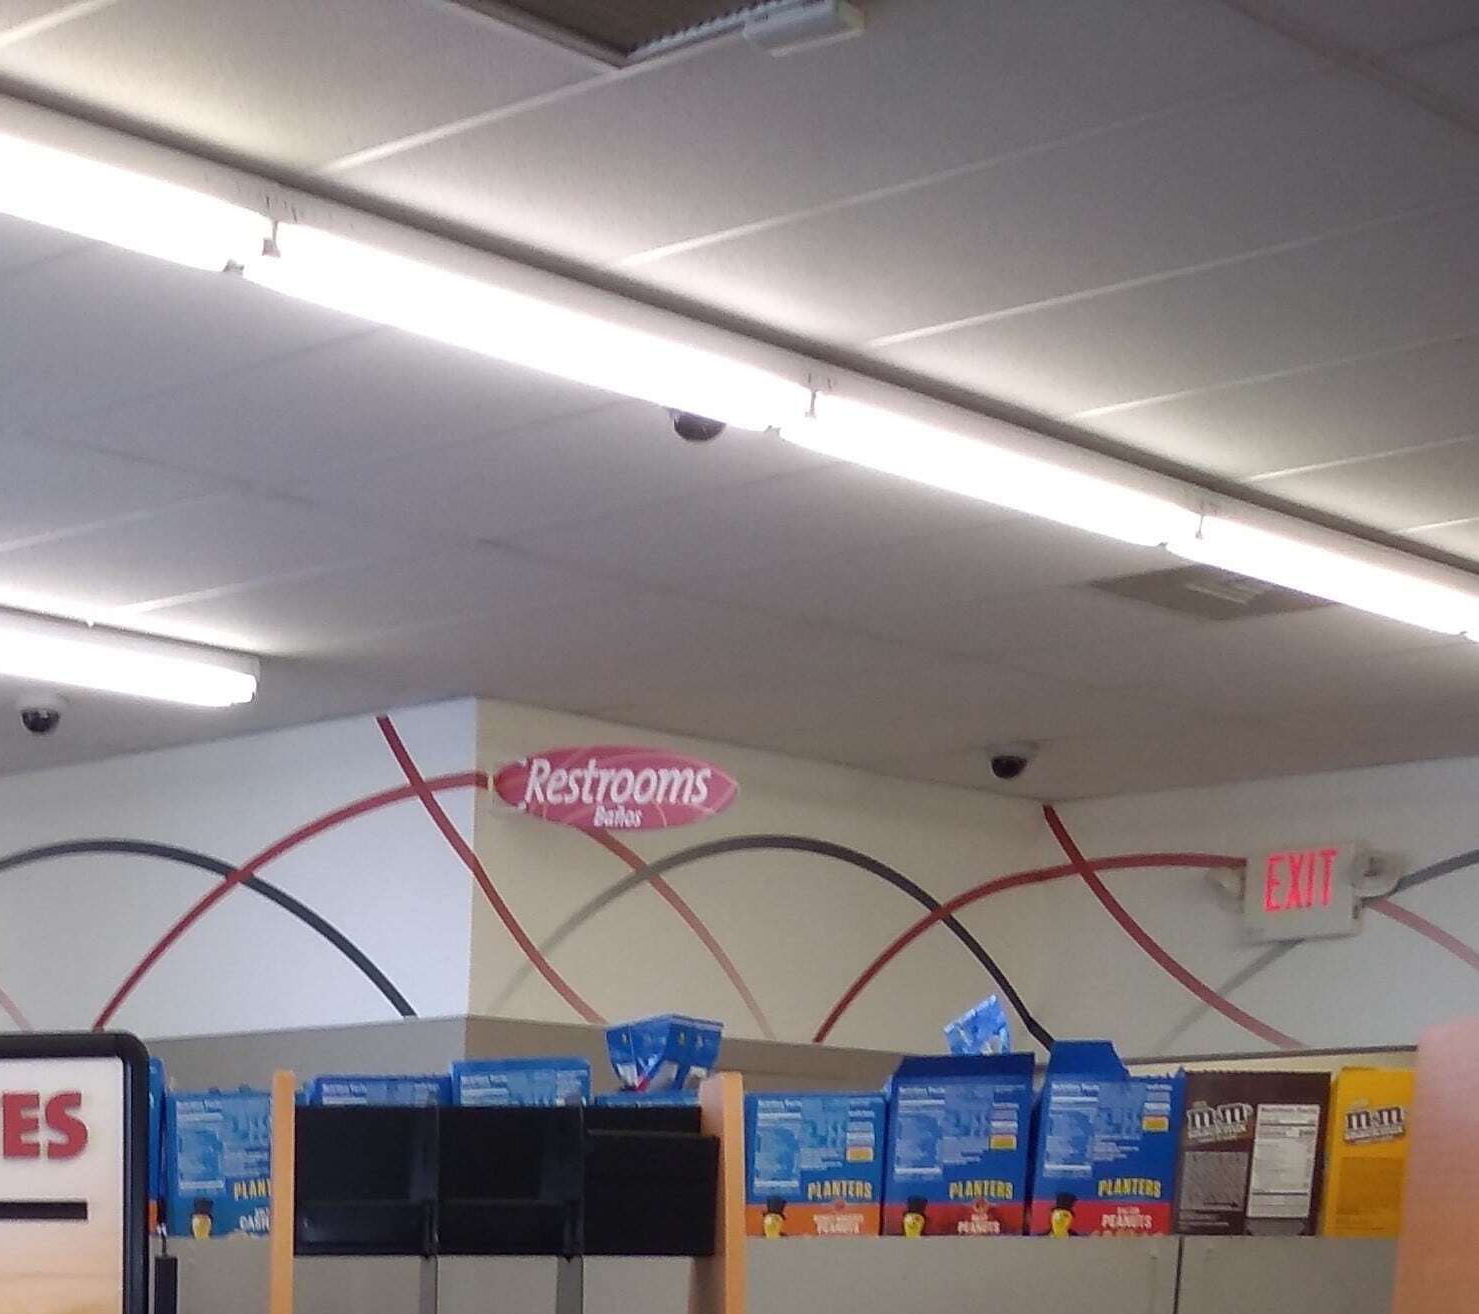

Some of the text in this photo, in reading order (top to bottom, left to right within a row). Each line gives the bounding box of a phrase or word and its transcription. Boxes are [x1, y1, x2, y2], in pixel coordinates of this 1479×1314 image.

[524, 757, 712, 804] Restrooms
[1264, 848, 1339, 912] EXIT
[807, 1180, 873, 1200] PLANTERS
[949, 1180, 1013, 1200] PLANTERS
[1098, 1178, 1161, 1198] PLANTERS
[1101, 1213, 1153, 1230] PEANUTS
